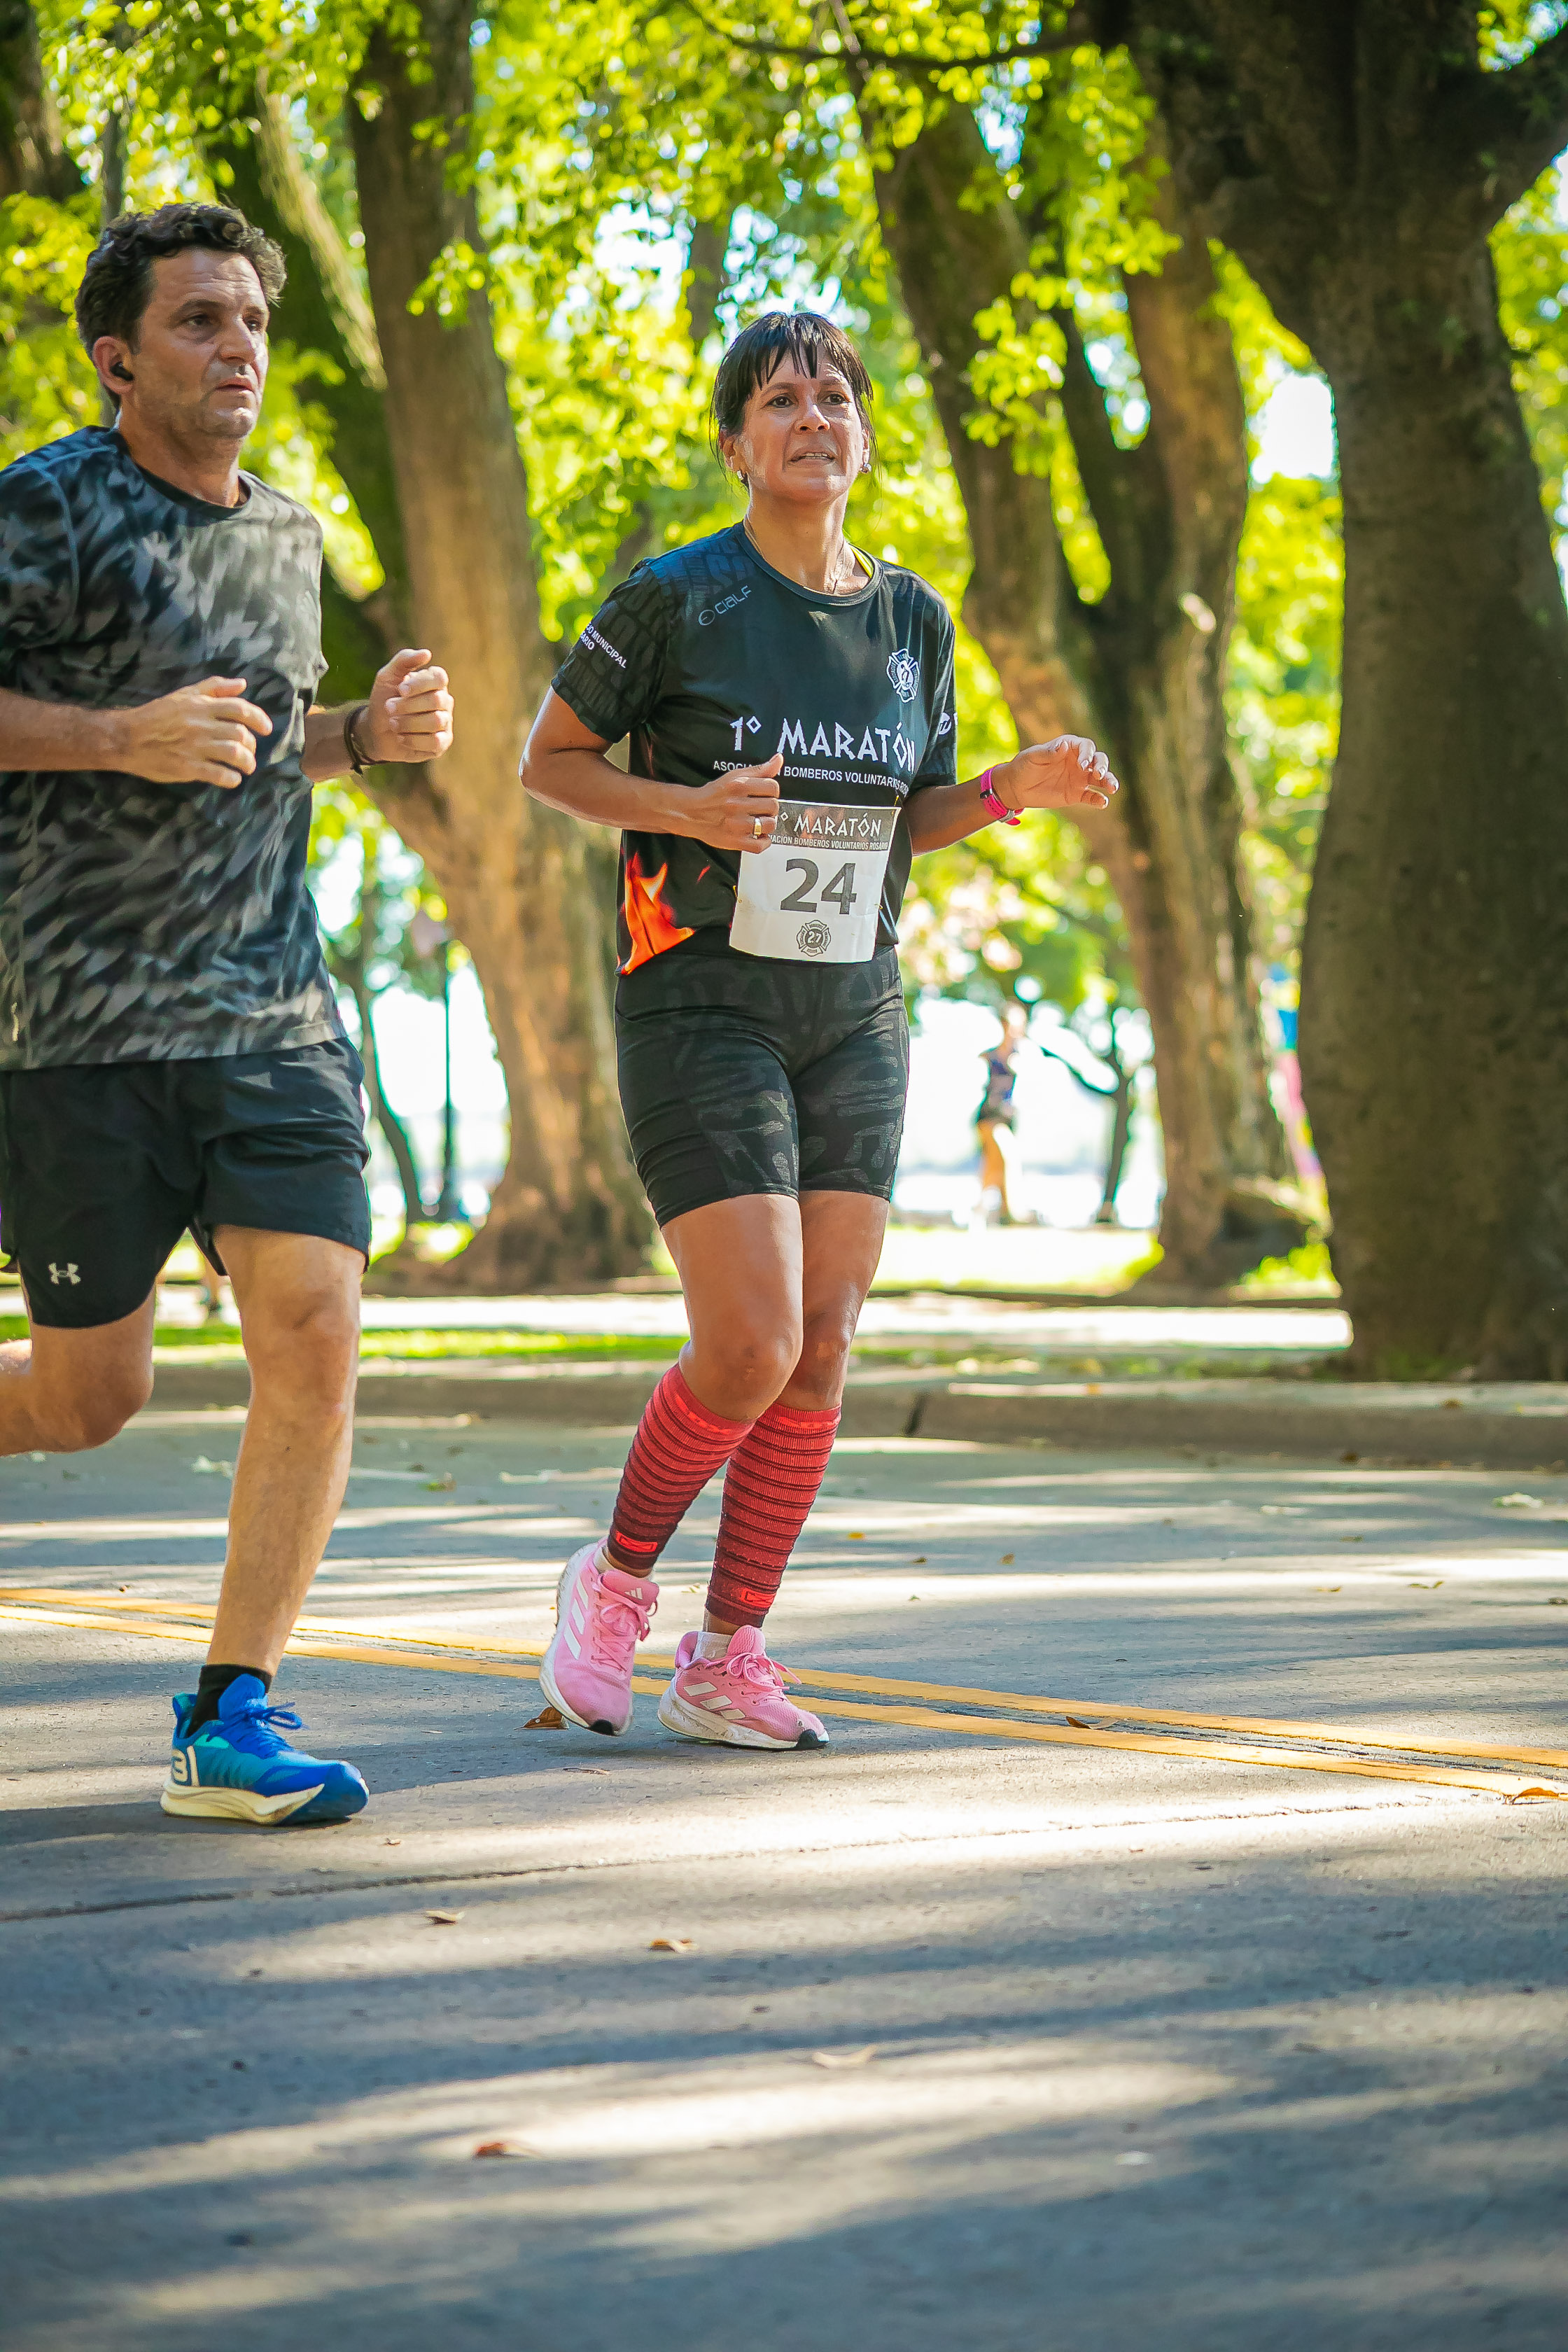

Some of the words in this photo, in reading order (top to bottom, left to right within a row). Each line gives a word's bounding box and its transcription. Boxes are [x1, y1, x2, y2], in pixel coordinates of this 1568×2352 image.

[591, 630, 627, 668] MUNICIPAL
[777, 718, 915, 775] MARATÓN
[784, 766, 843, 782] BOMBEROS
[793, 812, 882, 837] MARATÓN
[794, 837, 830, 848] BOMBEROS
[831, 840, 869, 850] VOLUNTARIOS
[780, 858, 857, 915] 24
[807, 931, 822, 944] 27
